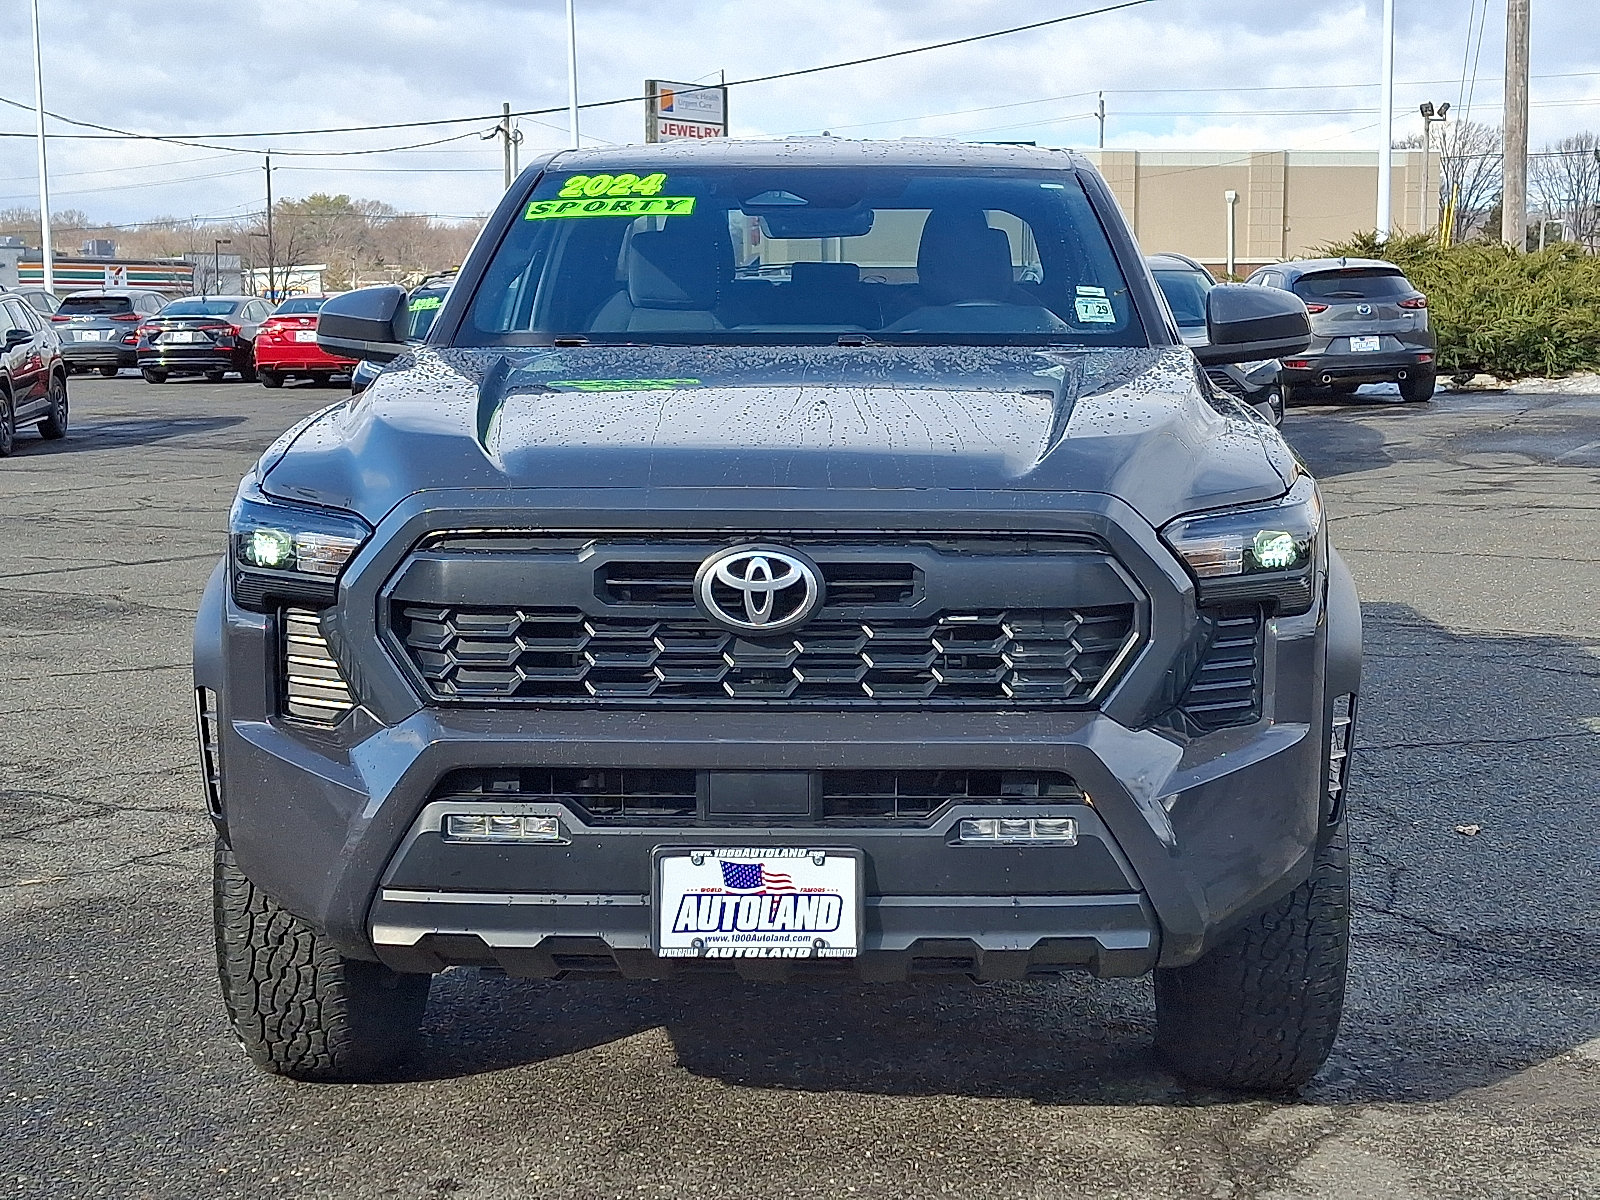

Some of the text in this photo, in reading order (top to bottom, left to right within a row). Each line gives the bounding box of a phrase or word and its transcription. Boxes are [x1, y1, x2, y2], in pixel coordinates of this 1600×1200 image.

[698, 101, 713, 109] Care
[660, 123, 721, 139] JEWELRY
[559, 173, 668, 198] 2024
[530, 200, 688, 215] SPORTY
[1082, 304, 1109, 314] 7 29
[672, 893, 843, 933] AUTOLAND
[705, 934, 811, 943] www.1800Autoland.com
[705, 947, 812, 958] AUTOLAND
